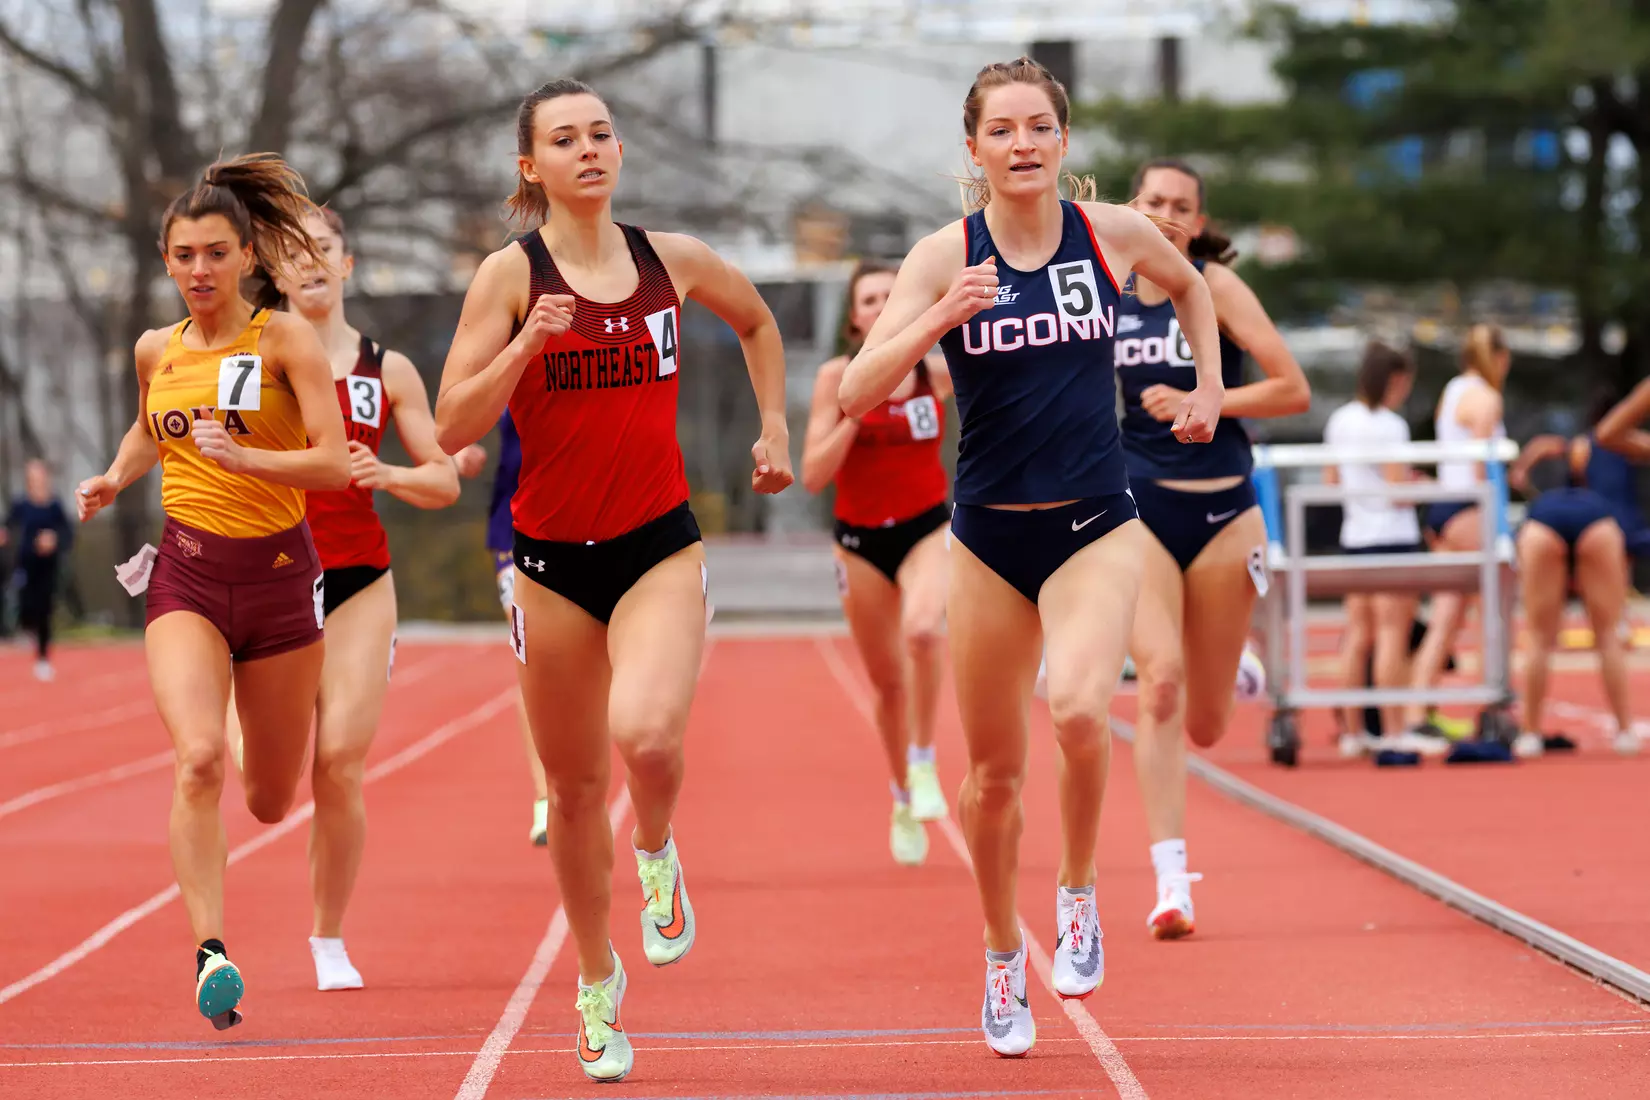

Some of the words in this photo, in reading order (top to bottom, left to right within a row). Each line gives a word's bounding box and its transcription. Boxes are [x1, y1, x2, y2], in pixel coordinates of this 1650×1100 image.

[1056, 264, 1093, 317] 5
[662, 311, 677, 366] 4
[228, 360, 255, 405] 7
[544, 342, 677, 392] NORTHEAST
[353, 381, 376, 420] 3
[914, 402, 931, 431] 8
